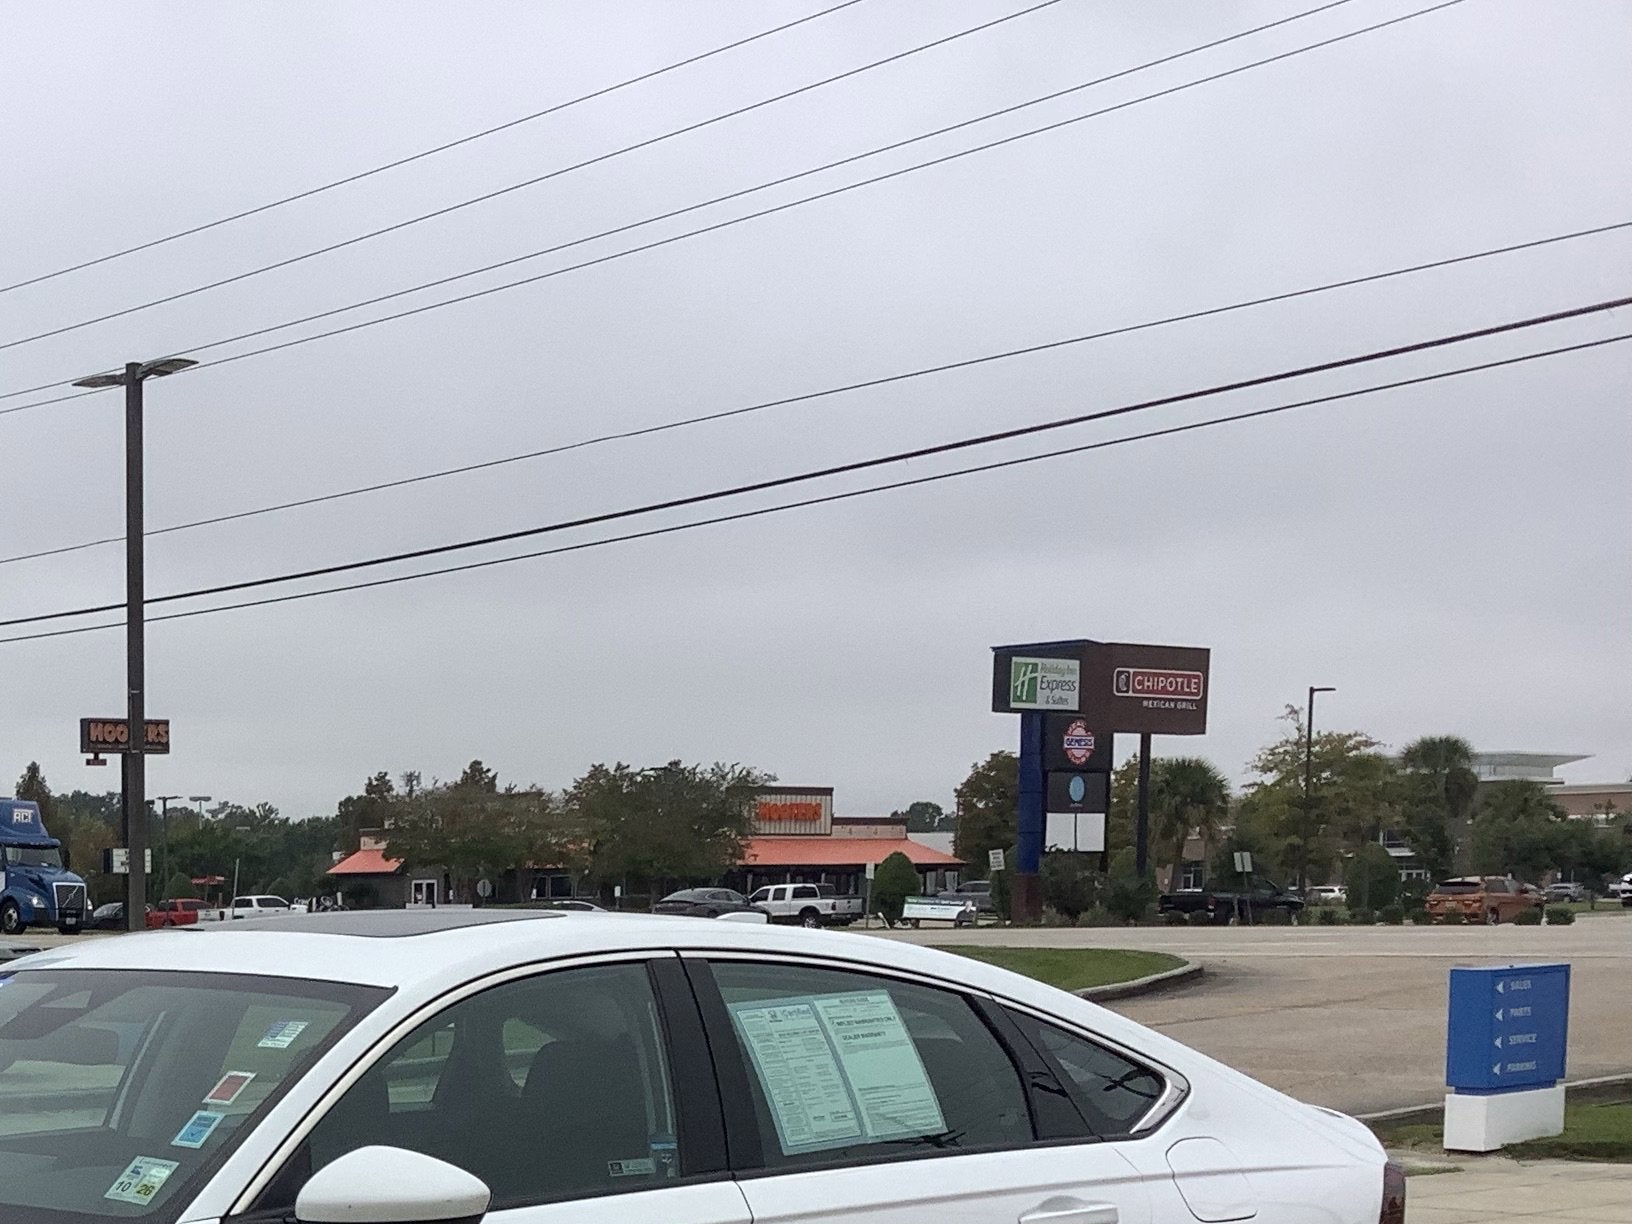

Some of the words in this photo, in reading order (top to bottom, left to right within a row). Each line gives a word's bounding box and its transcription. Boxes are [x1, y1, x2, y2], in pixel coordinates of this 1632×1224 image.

[1039, 675, 1077, 693] Express
[1134, 675, 1199, 693] CHIPOTLE
[1142, 700, 1176, 709] MEXICAN
[1176, 701, 1198, 710] GRILL
[115, 1180, 132, 1193] 10
[135, 1183, 156, 1197] 26
